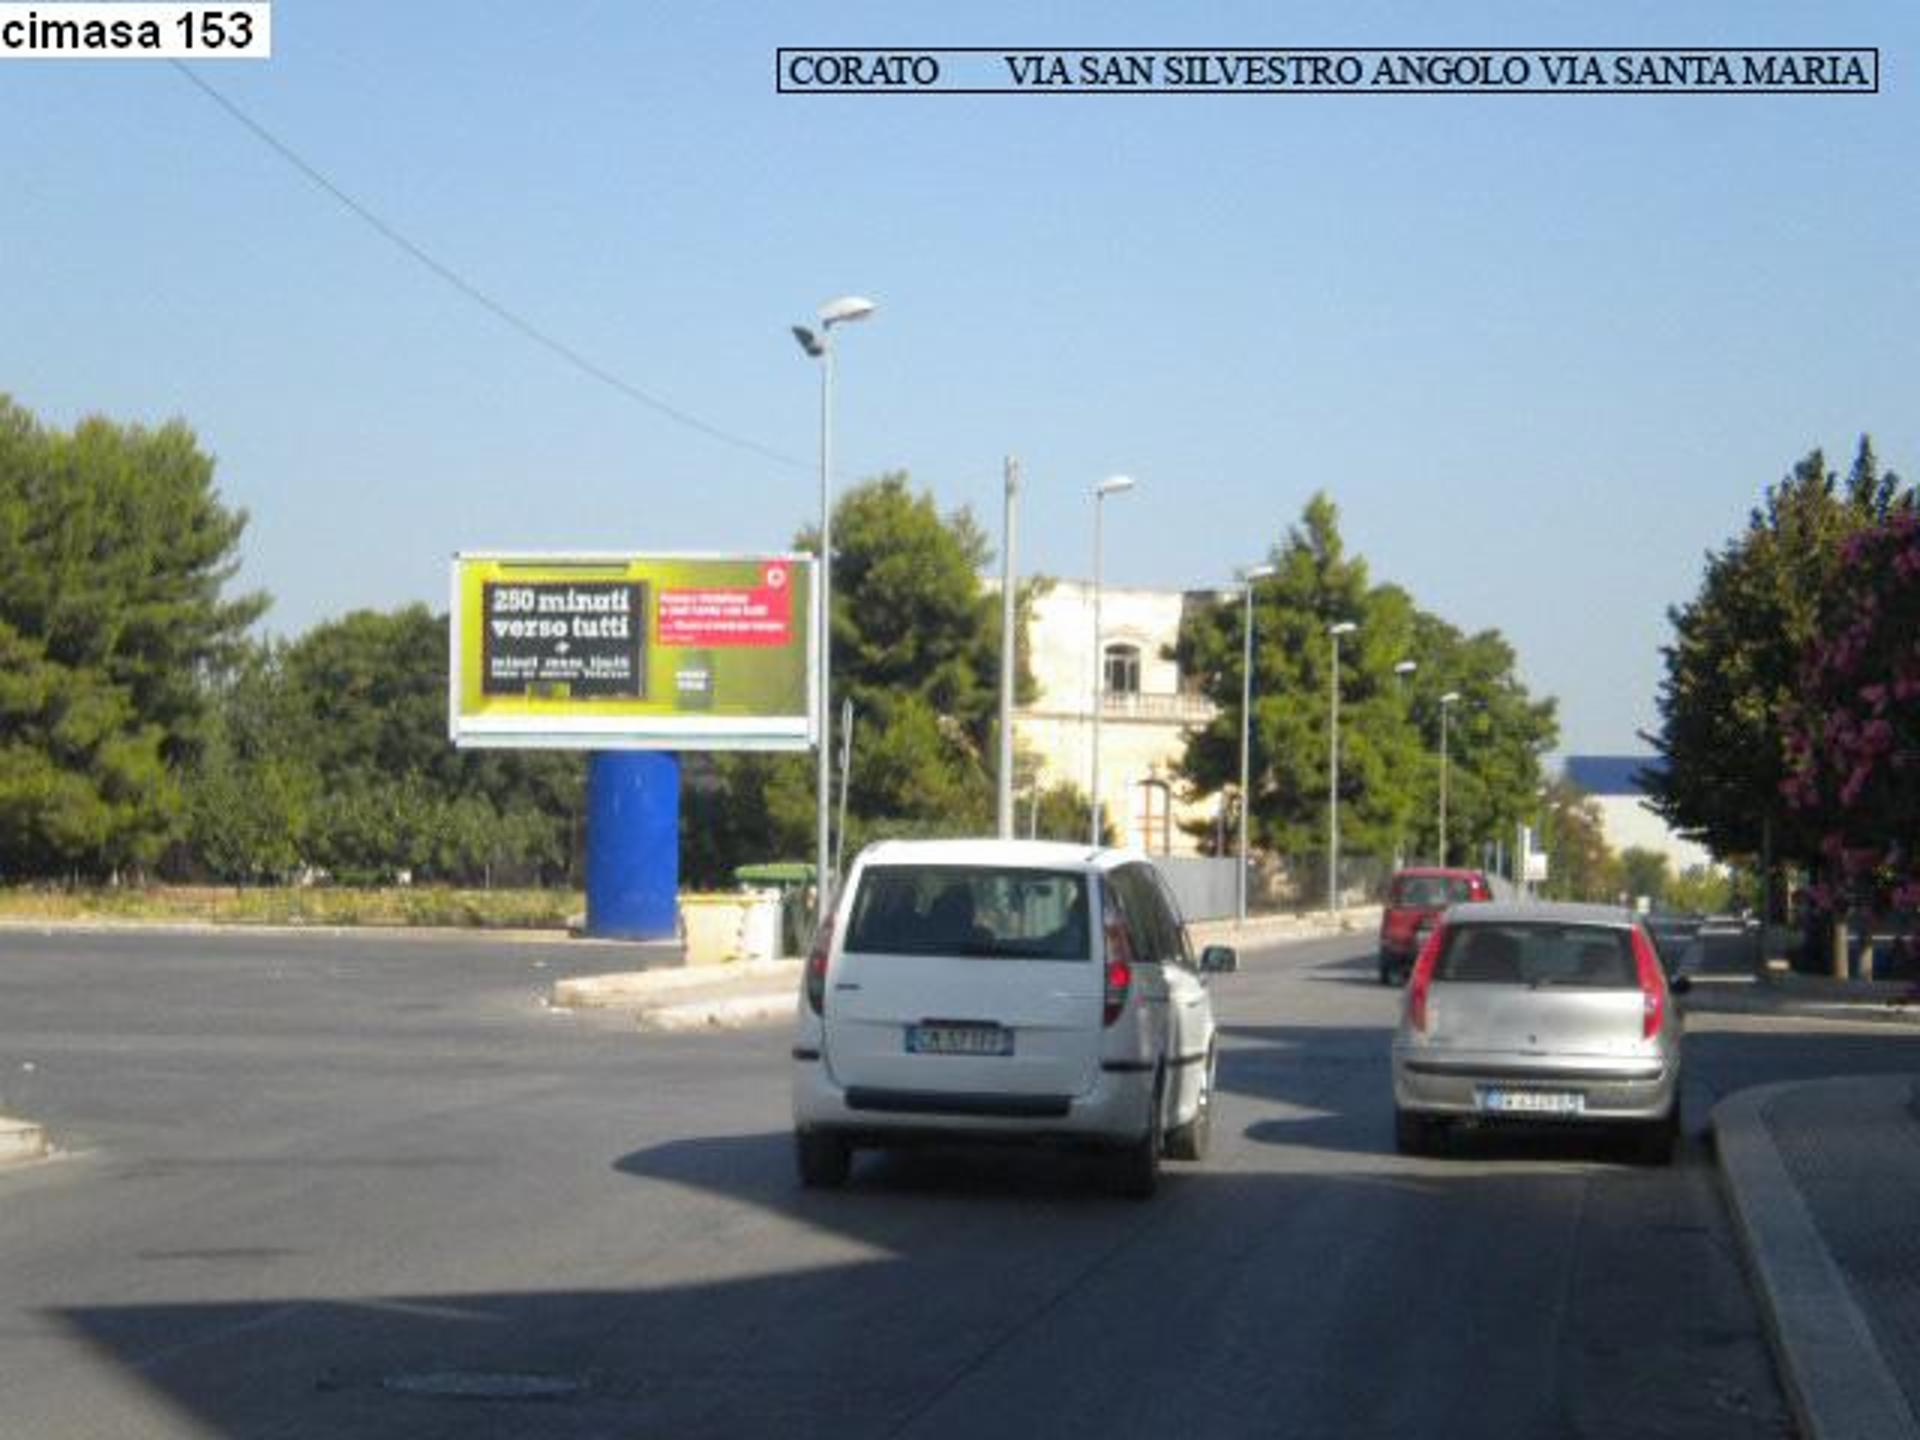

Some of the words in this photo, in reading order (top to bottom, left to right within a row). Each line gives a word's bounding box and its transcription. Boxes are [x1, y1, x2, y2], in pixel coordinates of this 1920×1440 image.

[537, 588, 630, 612] minuti
[490, 619, 569, 638] verso
[571, 615, 629, 638] tutti
